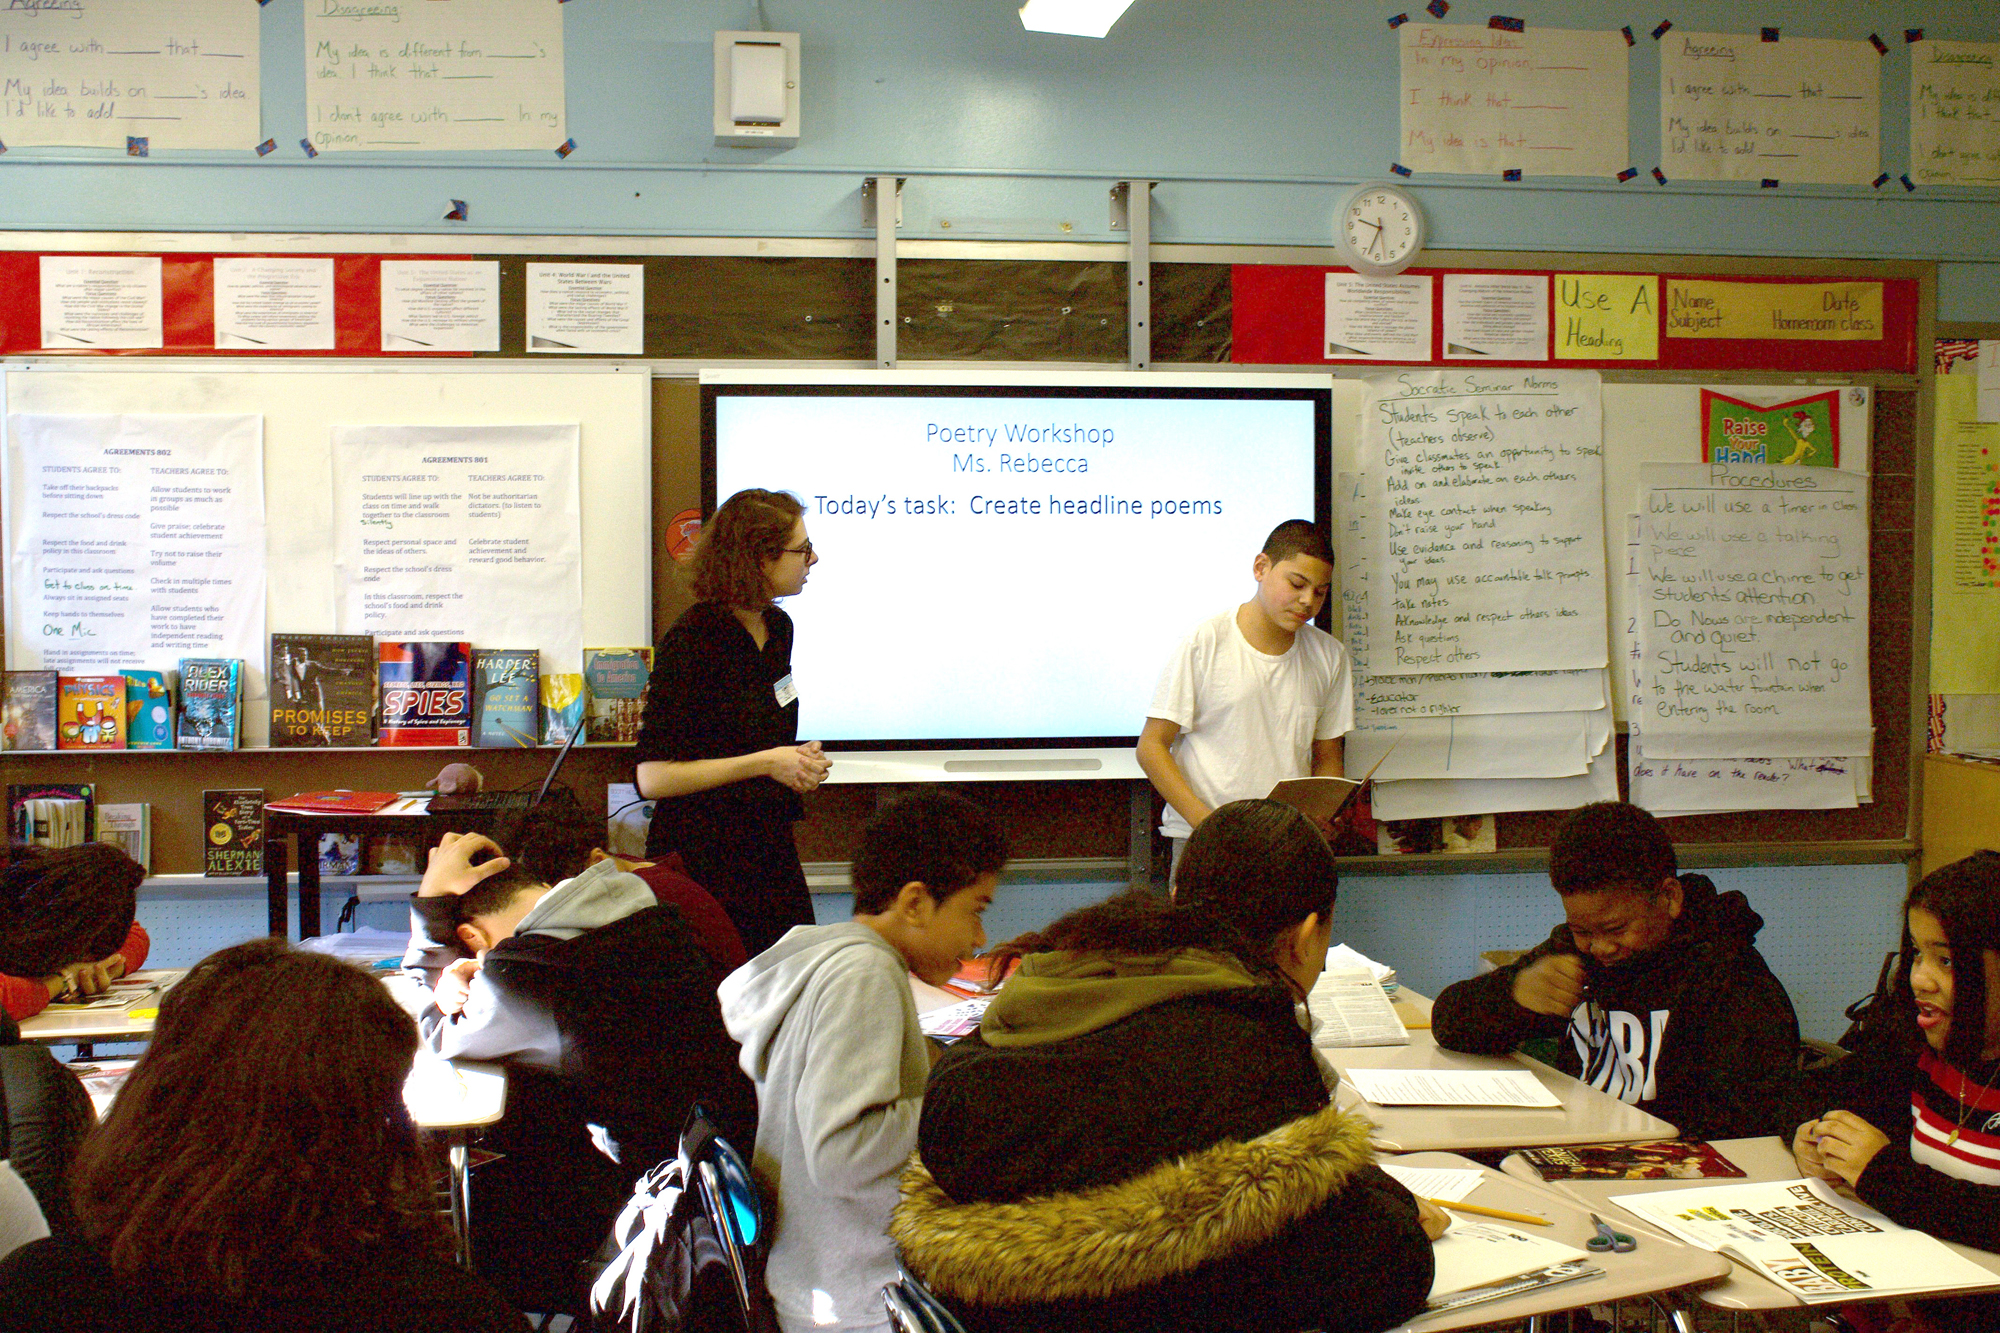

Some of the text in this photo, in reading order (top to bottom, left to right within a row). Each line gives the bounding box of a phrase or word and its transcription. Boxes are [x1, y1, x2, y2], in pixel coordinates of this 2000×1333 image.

[20, 42, 60, 60] agree
[69, 38, 104, 53] with
[166, 37, 199, 55] that
[315, 41, 482, 65] My idea is different from
[4, 79, 31, 105] My
[42, 79, 67, 96] idea
[81, 80, 120, 97] builds
[128, 87, 146, 98] on
[1439, 90, 1472, 106] think
[1486, 92, 1512, 108] that
[37, 102, 57, 117] like
[66, 103, 76, 118] to
[87, 102, 115, 119] add
[371, 109, 403, 127] agree
[411, 106, 448, 122] with
[540, 109, 558, 127] my
[1408, 130, 1435, 154] My
[1475, 135, 1489, 147] is
[1498, 130, 1526, 147] that
[1363, 199, 1372, 207] 11
[1377, 196, 1385, 205] 12
[1393, 201, 1398, 210] 1
[1352, 208, 1361, 216] 10
[1402, 213, 1408, 221] 2
[1348, 222, 1354, 230] 9
[1404, 227, 1411, 235] 3
[1351, 236, 1357, 244] 8
[1400, 241, 1406, 249] 4
[1362, 246, 1367, 255] 7
[1374, 253, 1381, 261] 6
[1389, 250, 1395, 259] 5
[1562, 279, 1652, 315] Use A
[1673, 287, 1861, 313] Name Date
[1669, 308, 1723, 333] Subject
[1841, 310, 1875, 331] class
[1566, 317, 1624, 355] Heading
[1398, 373, 1558, 397] Socratic Seminar Norms
[1379, 402, 1579, 427] Students speak to each other
[927, 422, 1115, 447] Poetry Workshop
[1722, 417, 1768, 436] Raise
[1388, 426, 1496, 451] (teachers observe)
[1728, 436, 1760, 451] Your
[103, 448, 155, 456] AGREEMENTS
[422, 456, 473, 464] AGREEMENTS
[1385, 448, 1494, 467] Give classmates an
[1715, 444, 1767, 464] Hand
[151, 467, 189, 475] TEACHERS
[952, 452, 1089, 473] Ms. Rebecca
[1710, 464, 1818, 489] Procedures
[814, 494, 1222, 519] Today's task: Create headline poems
[1649, 493, 1673, 514] We
[1682, 494, 1715, 514] will
[1725, 501, 1751, 514] use
[1762, 503, 1772, 514] a
[1779, 496, 1814, 514] timer
[63, 580, 72, 590] to
[1391, 569, 1553, 597] You may use accountable talk
[1648, 567, 1674, 583] We
[1682, 568, 1716, 583] will
[1717, 573, 1742, 583] use
[1747, 572, 1758, 583] a
[1819, 567, 1834, 582] to
[1838, 566, 1865, 596] get
[42, 621, 96, 638] One Mic
[1395, 632, 1460, 645] Ask questions
[477, 658, 531, 670] HARPER
[594, 658, 639, 671] Immigration
[1395, 646, 1480, 668] Respect others
[187, 665, 228, 679] ALEX
[1657, 651, 1848, 683] Students will not go
[184, 678, 229, 692] RIDER
[491, 672, 516, 683] LEE
[597, 672, 636, 682] to America
[9, 685, 47, 694] AMERICA
[64, 684, 116, 697] PHYSICS
[383, 690, 465, 715] SPIES
[273, 709, 367, 724] PROMISES
[1657, 700, 1780, 723] entering the room
[287, 726, 351, 736] TO KEEP
[207, 850, 261, 860] SHERMAN
[208, 860, 260, 871] ALEXIE
[1791, 1242, 1874, 1290] PROTEIN
[1762, 1258, 1847, 1293] BABY
